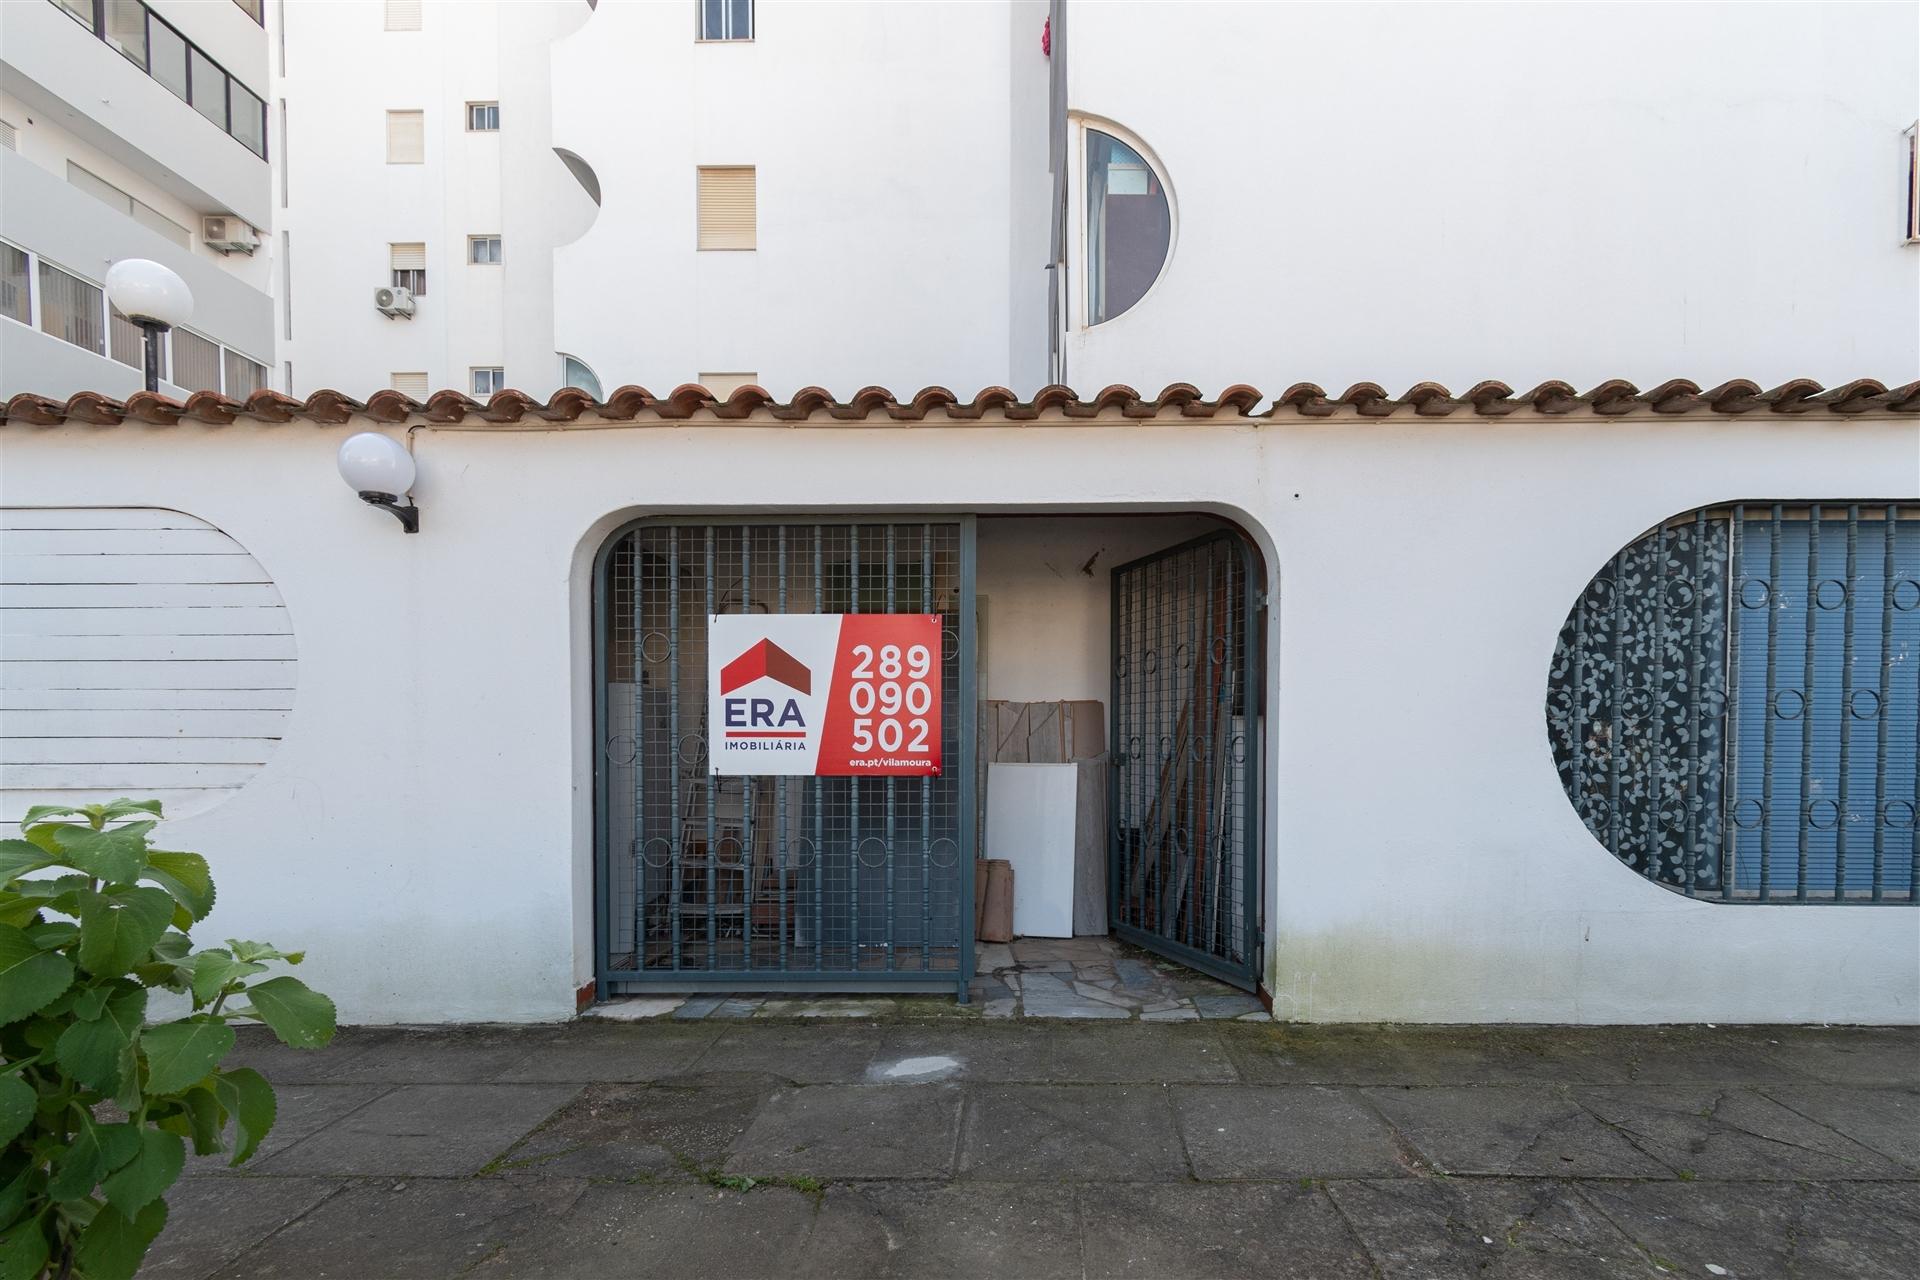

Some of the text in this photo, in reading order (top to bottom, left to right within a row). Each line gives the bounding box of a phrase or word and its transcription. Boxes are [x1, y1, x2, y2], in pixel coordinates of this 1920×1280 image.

[851, 644, 931, 679] 289
[725, 698, 806, 727] ERA
[849, 681, 932, 716] 090
[725, 739, 806, 751] IMOBILIÁRIA
[852, 718, 929, 752] 502
[849, 757, 932, 769] era.pt/vilamoura
